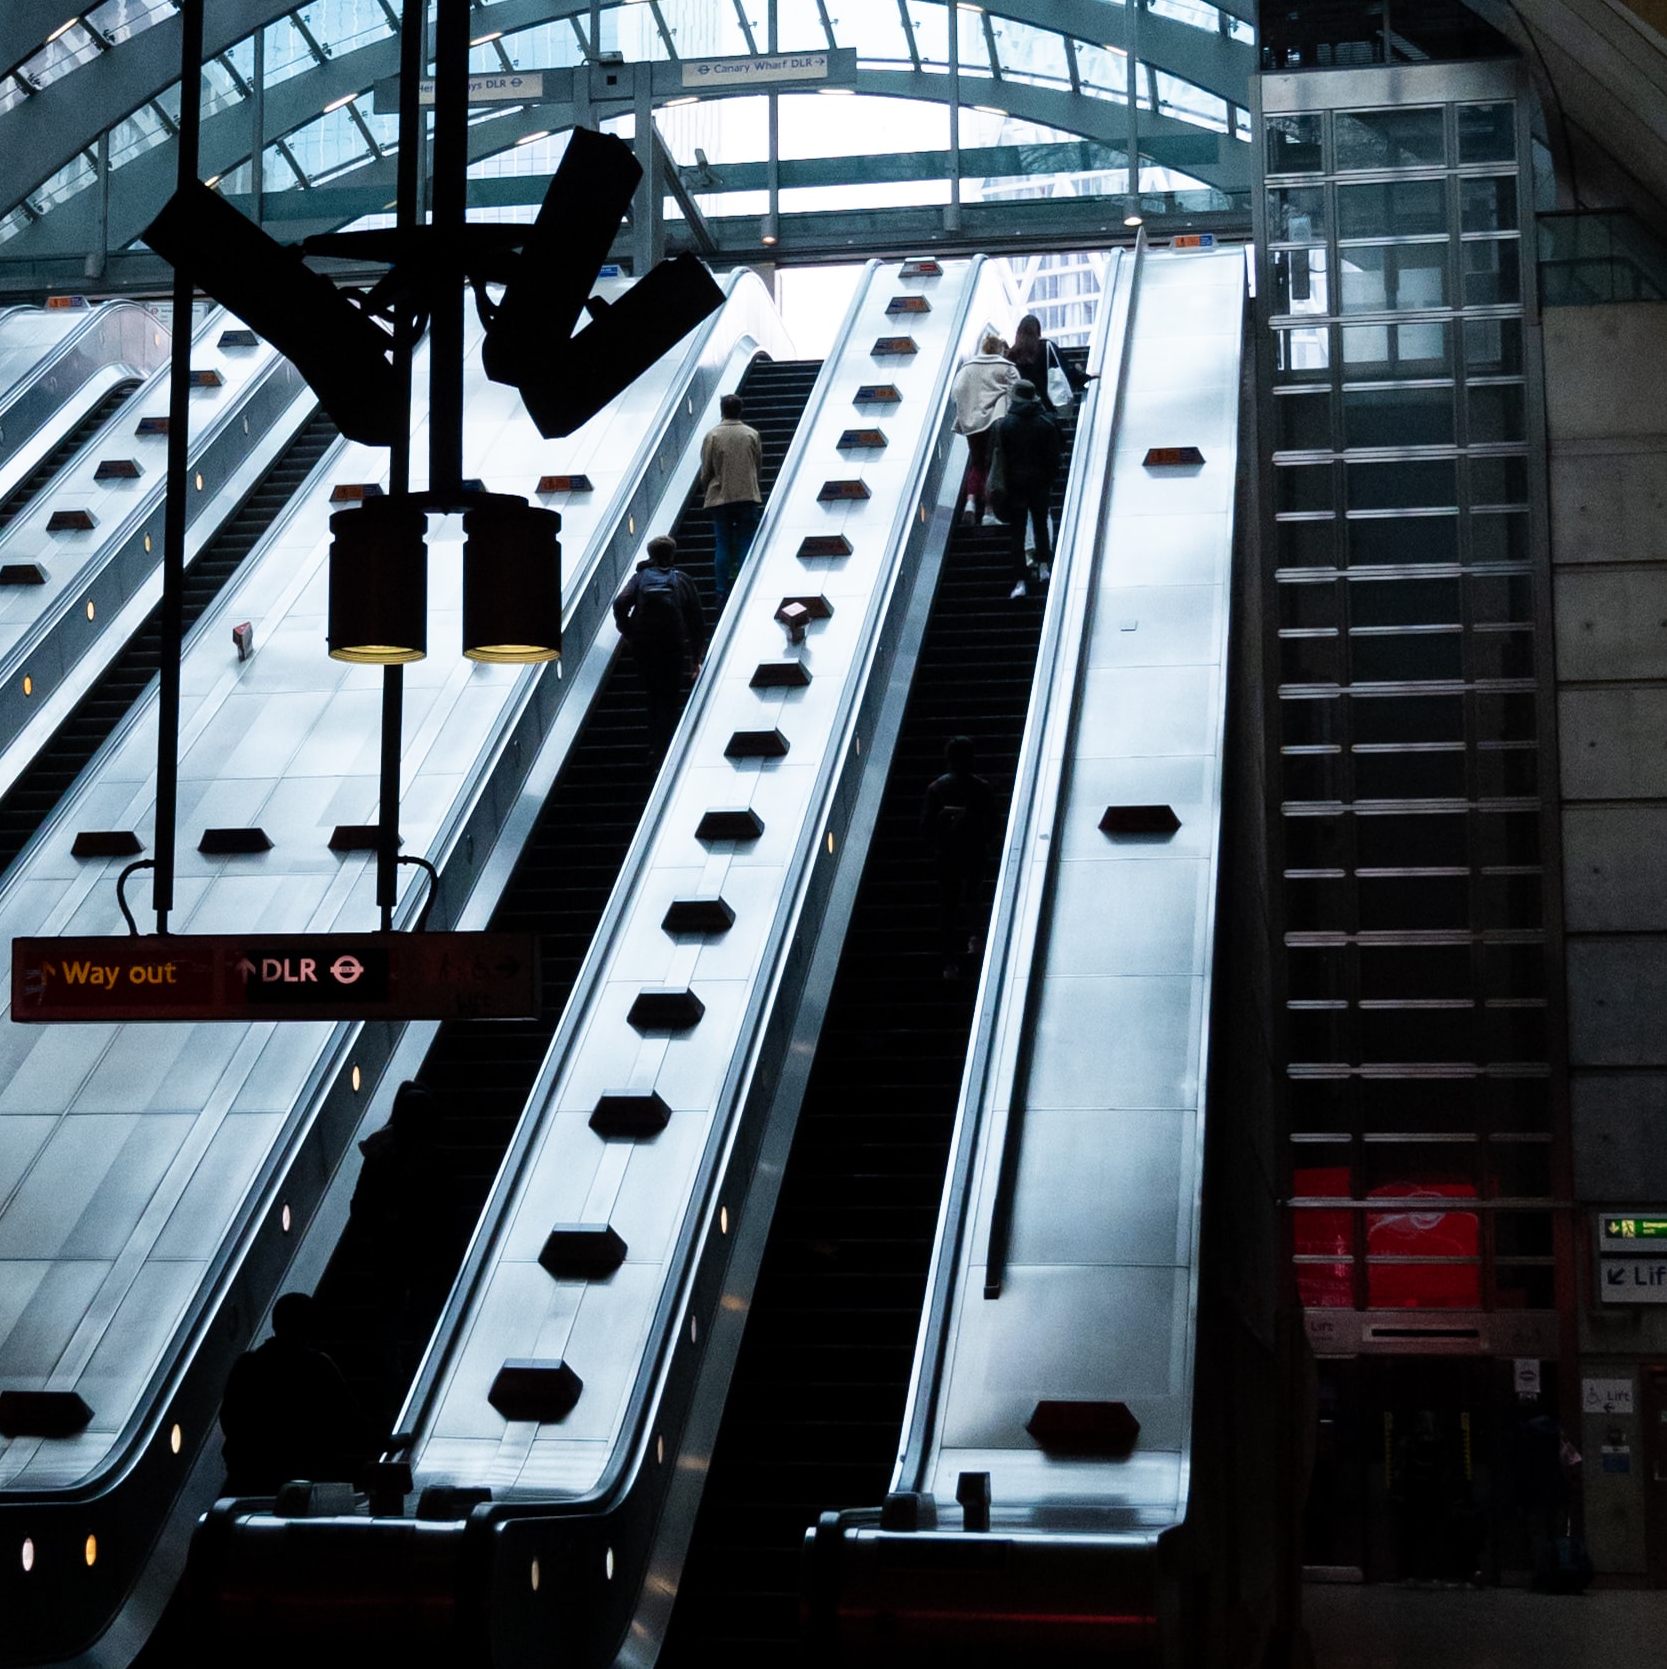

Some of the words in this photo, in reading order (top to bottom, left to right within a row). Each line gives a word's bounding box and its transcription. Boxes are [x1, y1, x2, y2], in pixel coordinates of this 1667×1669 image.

[714, 63, 751, 75] Canary
[753, 58, 787, 71] Wharf
[791, 57, 813, 68] DLR
[486, 79, 507, 89] DLR
[61, 960, 121, 991] Way
[128, 961, 178, 985] out
[261, 957, 319, 983] DLR
[1634, 1266, 1667, 1286] Lif
[1607, 1391, 1631, 1402] Lift
